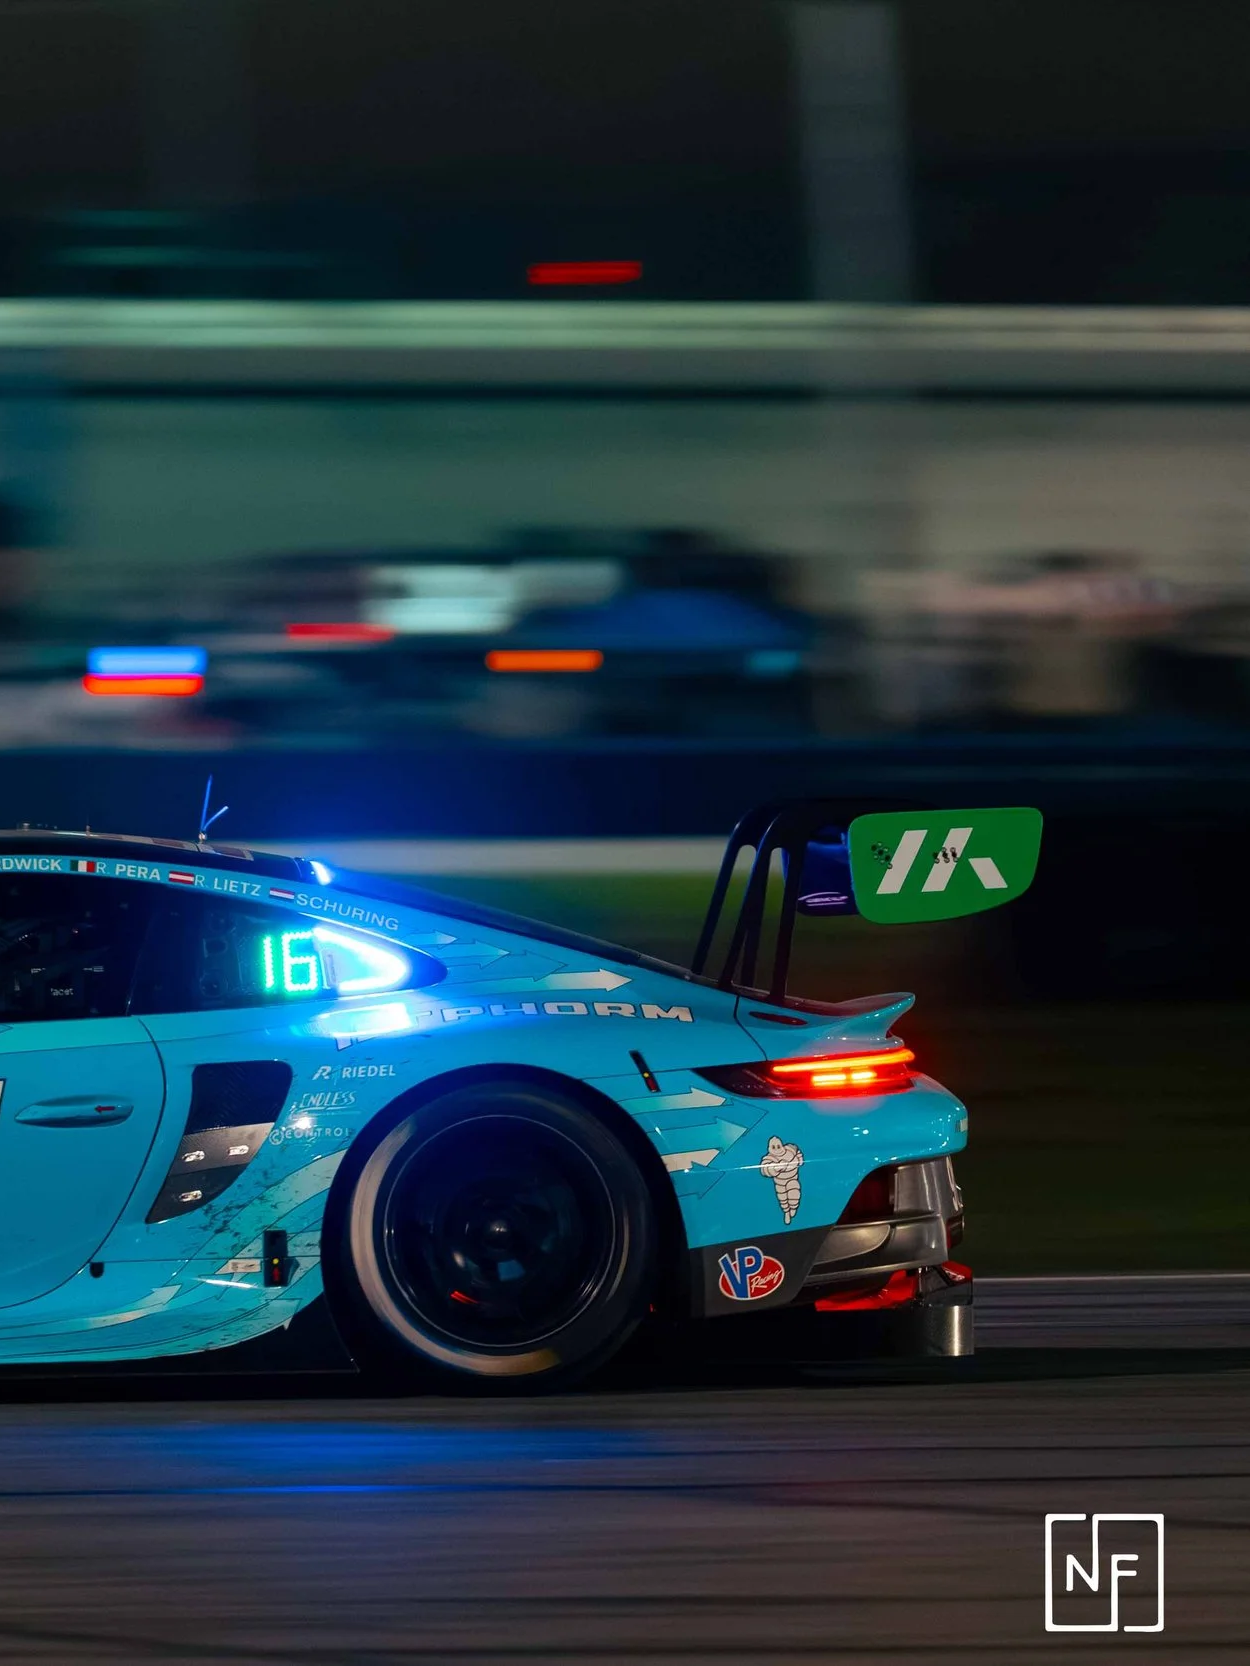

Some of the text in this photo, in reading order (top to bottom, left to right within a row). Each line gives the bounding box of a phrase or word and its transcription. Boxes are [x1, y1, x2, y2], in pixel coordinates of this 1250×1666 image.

[114, 863, 161, 881] PERA
[213, 876, 262, 897] LIETZ
[296, 892, 400, 931] SCHURING
[262, 930, 318, 992] 16
[342, 1064, 397, 1079] RIEDEL
[299, 1089, 358, 1109] ENDLESS
[718, 1246, 764, 1300] VP
[750, 1269, 783, 1293] Racing
